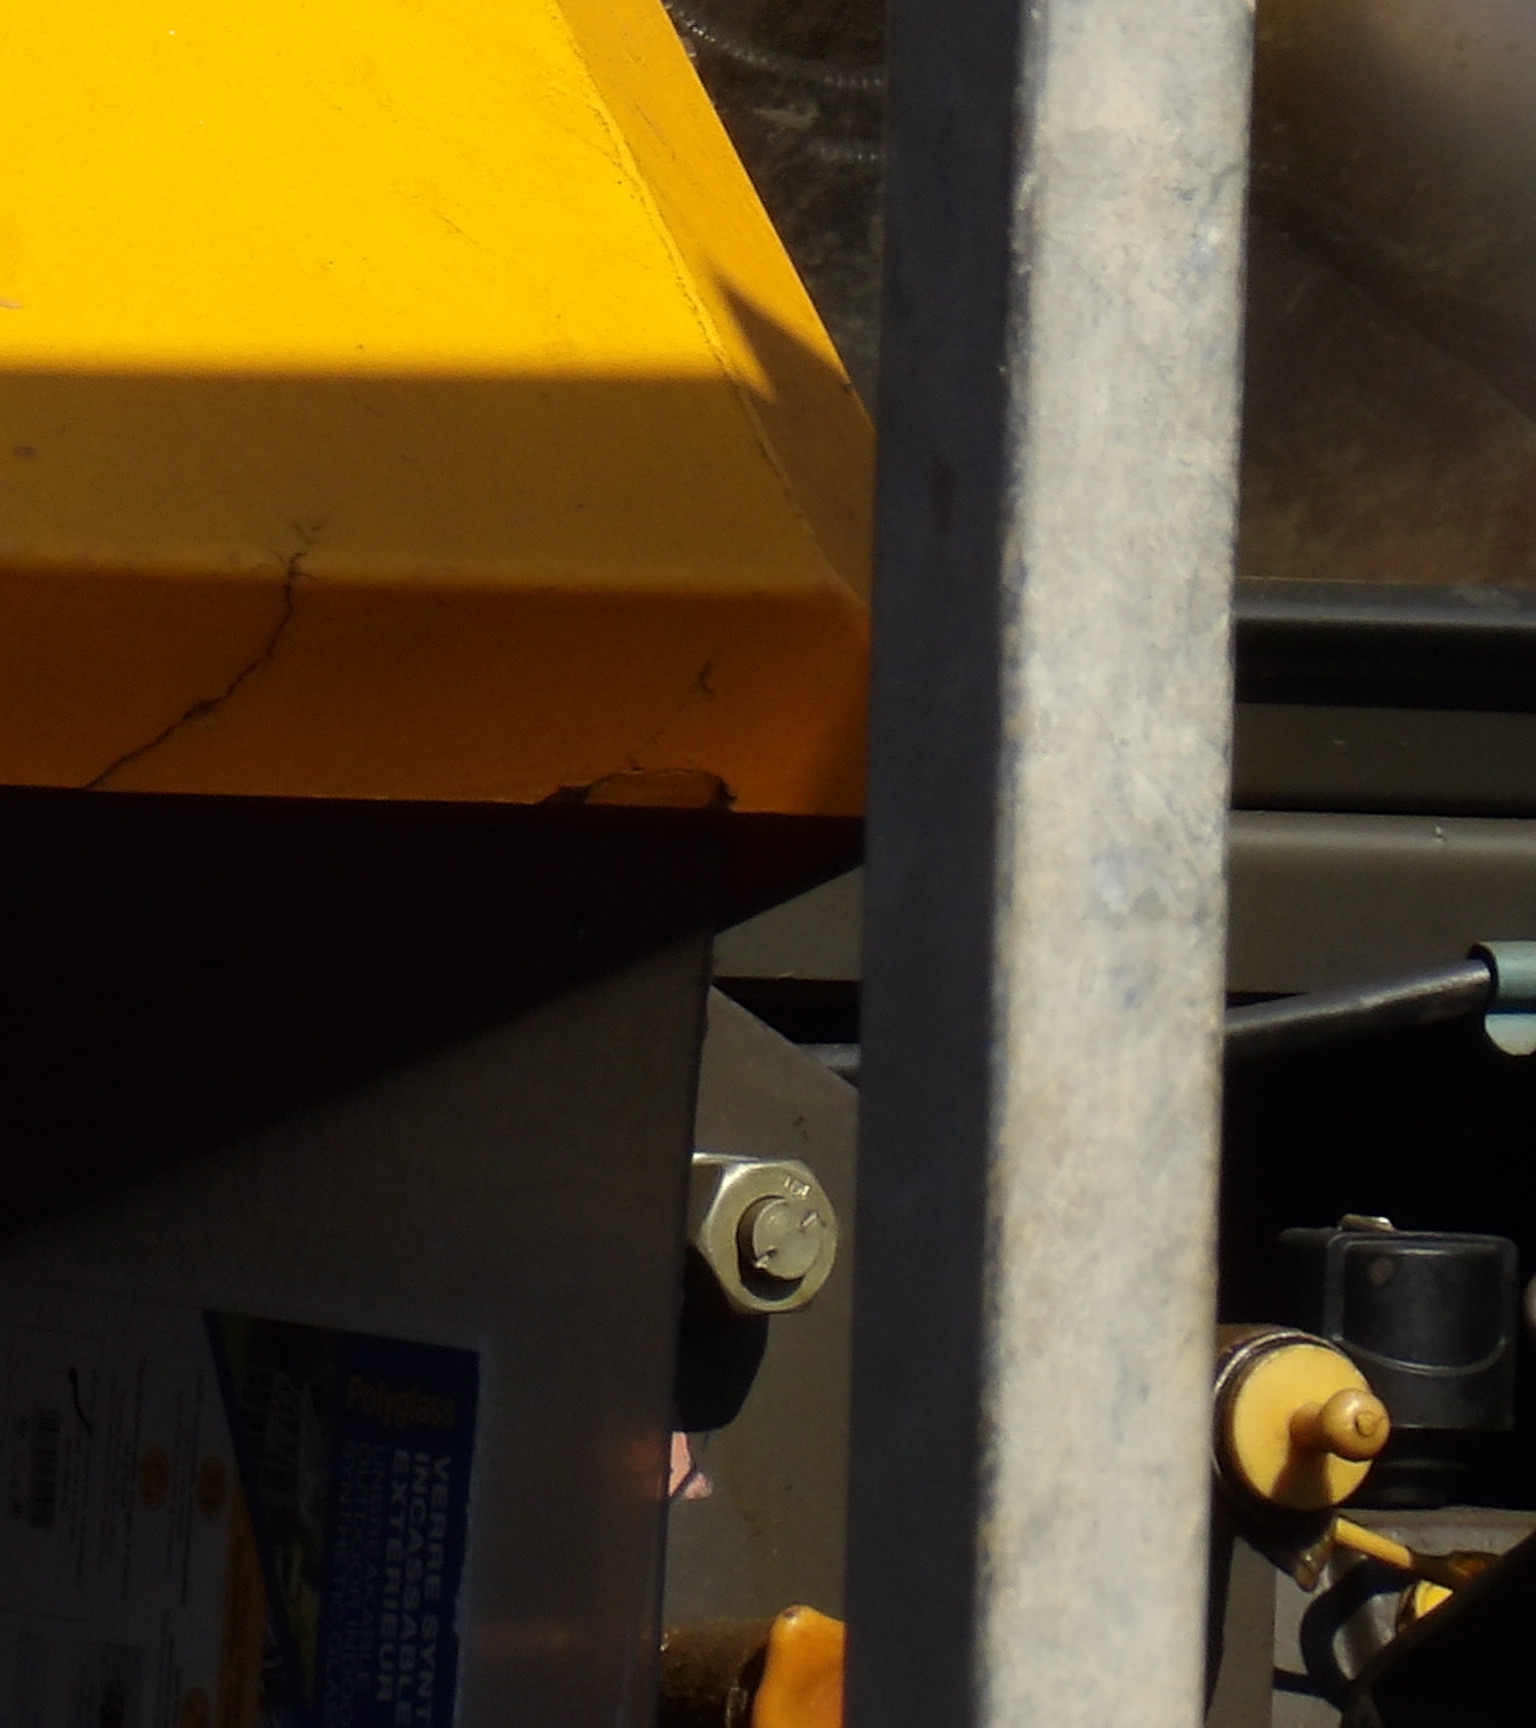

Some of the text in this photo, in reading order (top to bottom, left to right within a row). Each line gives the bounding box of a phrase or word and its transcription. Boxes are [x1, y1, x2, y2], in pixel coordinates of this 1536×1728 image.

[346, 1374, 455, 1429] Polyglass
[330, 1439, 357, 1621] SYNTHETIC
[344, 1442, 372, 1609] OUTDOOR
[356, 1444, 387, 1689] UNBREAKABLE
[393, 1451, 430, 1728] INCASSABLE
[423, 1455, 451, 1601] VERRE
